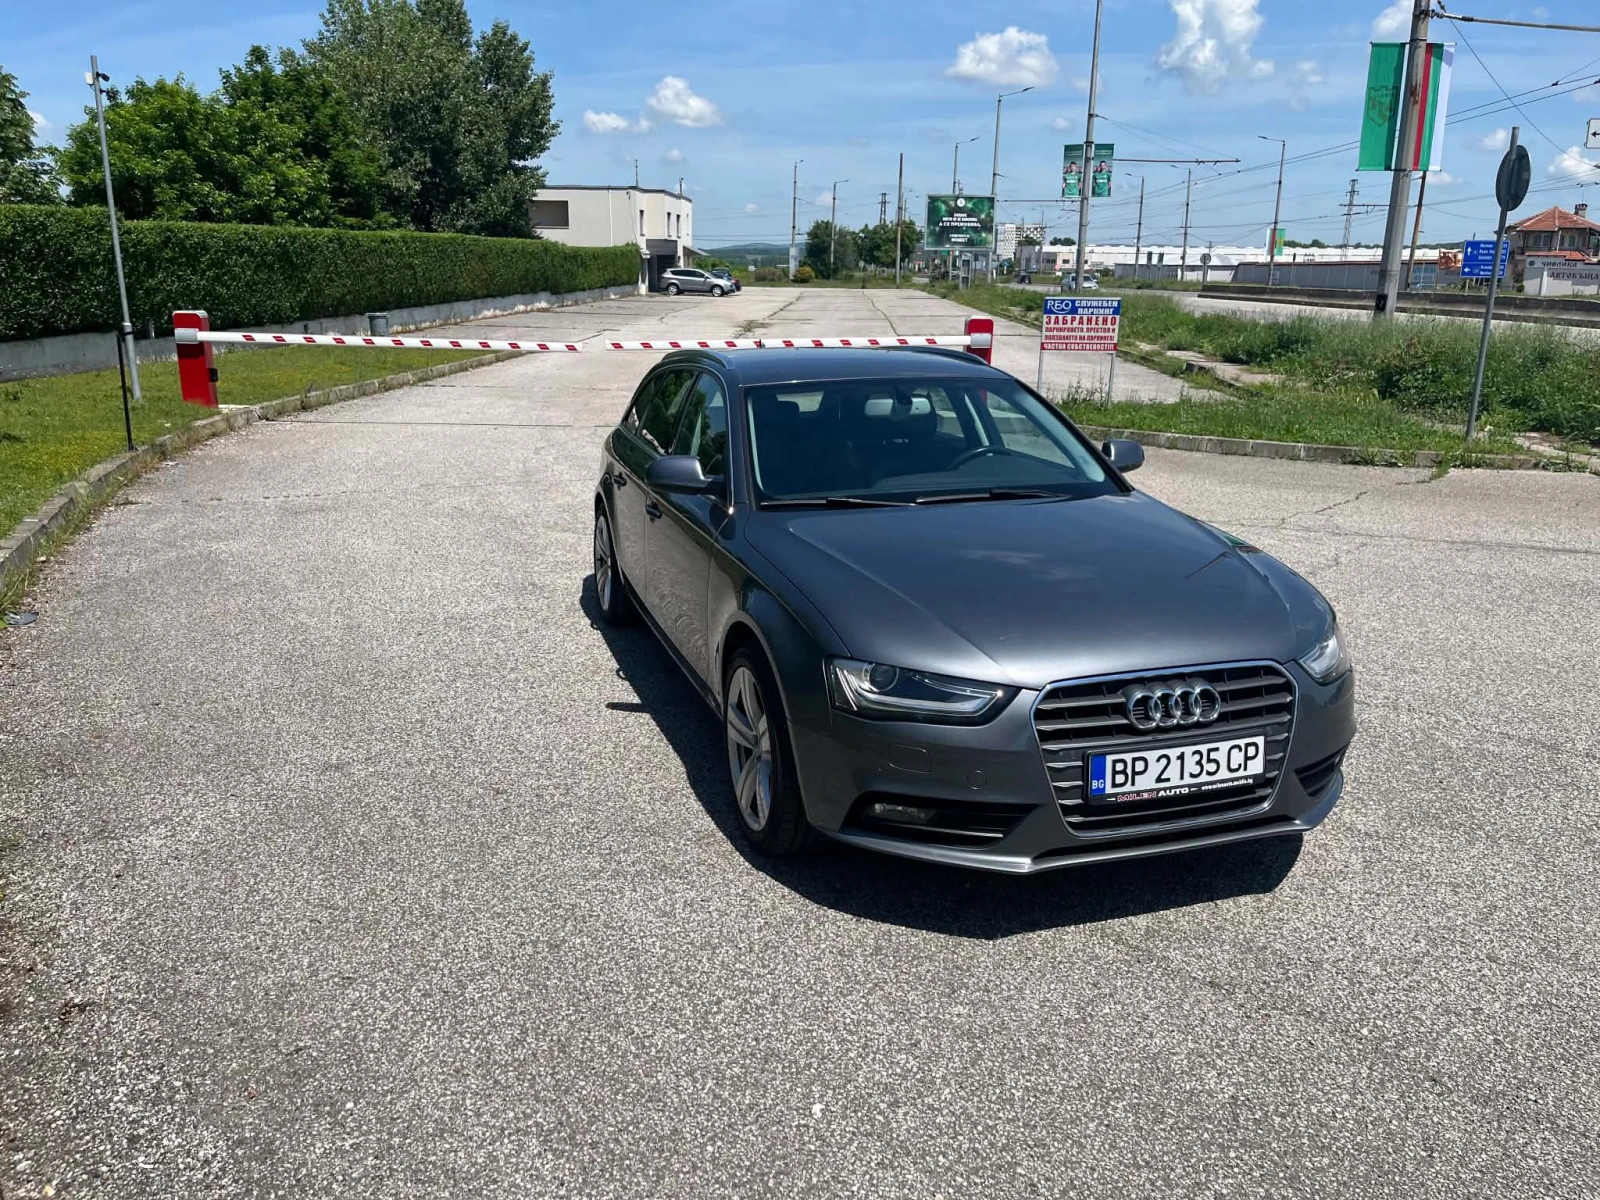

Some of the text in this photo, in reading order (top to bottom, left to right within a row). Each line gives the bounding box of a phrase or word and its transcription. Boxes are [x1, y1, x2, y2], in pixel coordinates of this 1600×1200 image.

[1045, 315, 1117, 326] ЗАБРАНЕНО
[1111, 741, 1260, 789] BP 2135 CP
[1091, 779, 1105, 790] BG
[1117, 791, 1157, 802] MILEN
[1158, 787, 1189, 798] AUTO
